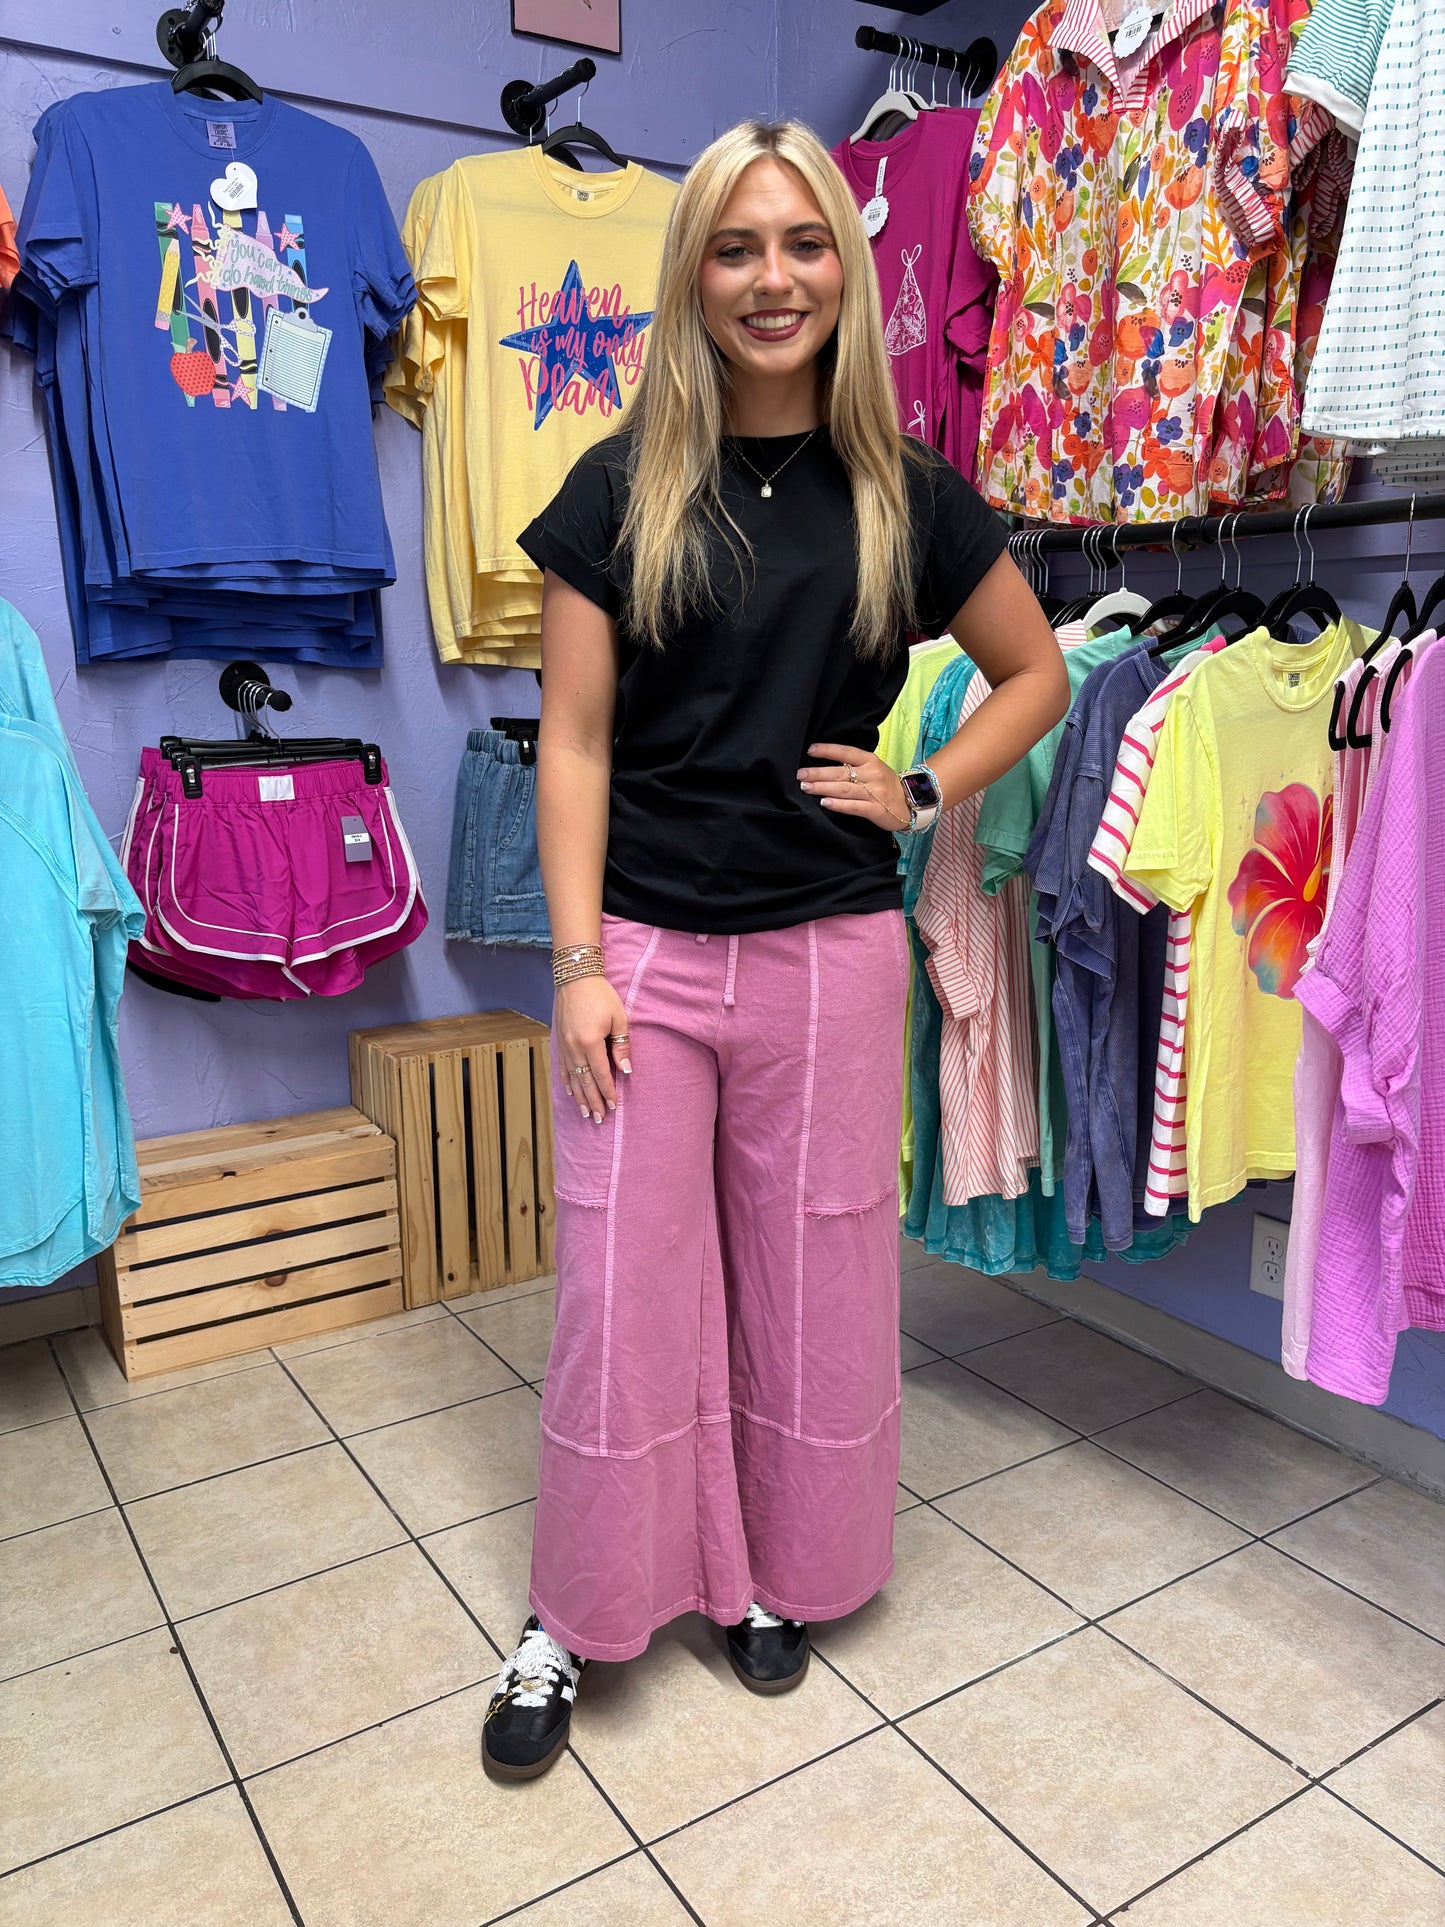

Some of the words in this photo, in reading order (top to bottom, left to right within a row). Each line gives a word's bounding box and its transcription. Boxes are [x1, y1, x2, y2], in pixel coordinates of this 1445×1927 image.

[222, 264, 242, 286] do
[243, 266, 276, 294] hard
[277, 275, 313, 302] things
[230, 239, 256, 264] you
[257, 252, 283, 277] can
[516, 282, 631, 333] Heaven
[530, 328, 553, 357] is
[555, 326, 589, 373] my
[592, 322, 646, 386] only
[518, 356, 617, 418] Plan
